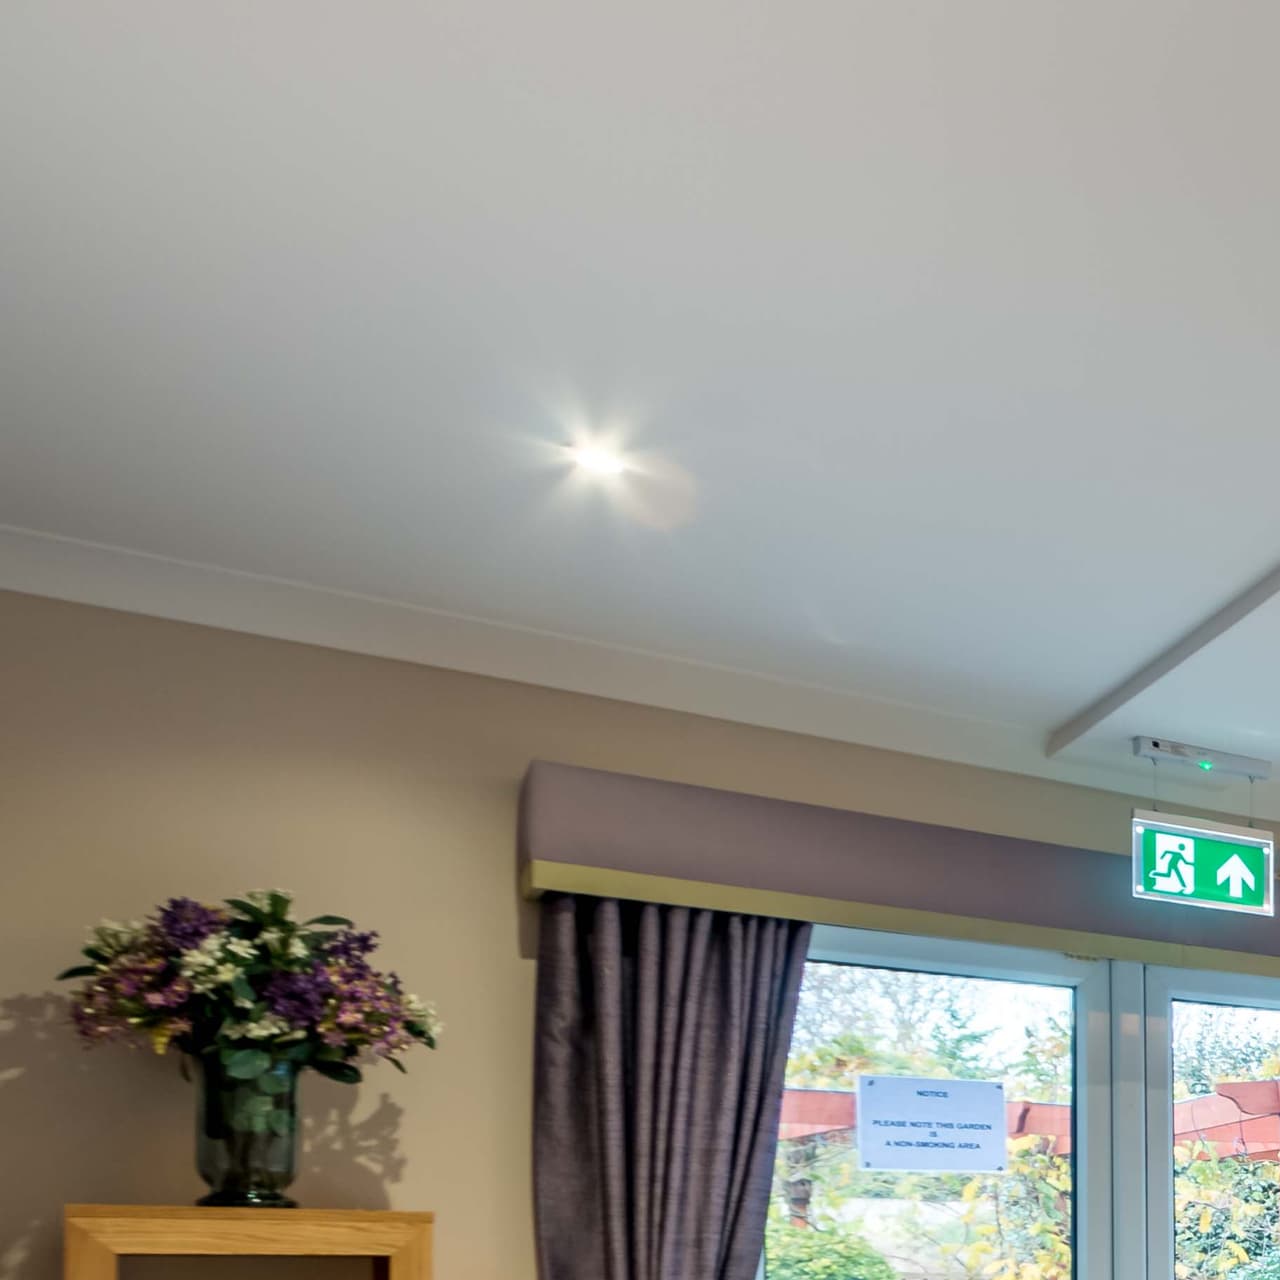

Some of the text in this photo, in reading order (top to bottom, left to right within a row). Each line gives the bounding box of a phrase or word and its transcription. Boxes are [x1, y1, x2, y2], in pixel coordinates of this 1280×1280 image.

[916, 1090, 949, 1098] NOTICE
[872, 1119, 992, 1131] PLEASE NOTE THIS GARDEN
[893, 1140, 955, 1149] NON-SMOKING
[957, 1141, 981, 1150] AREA
